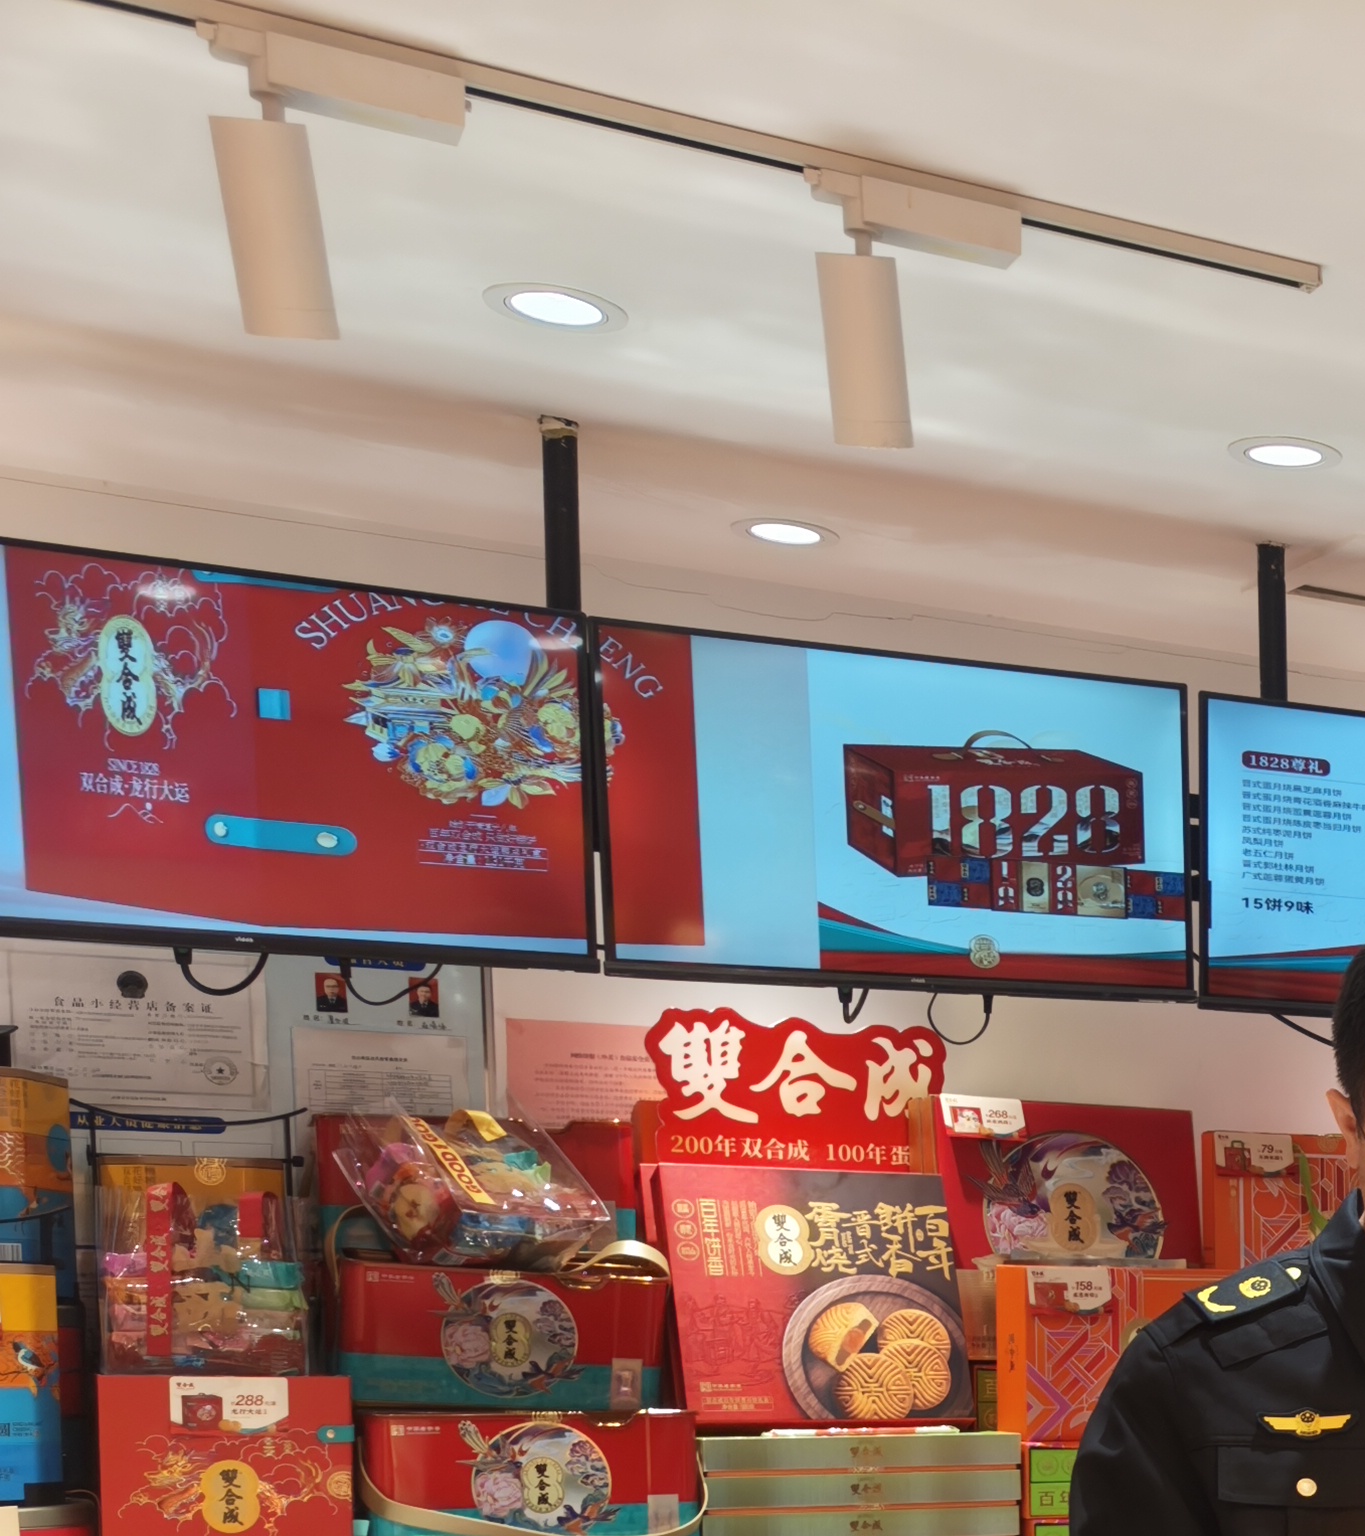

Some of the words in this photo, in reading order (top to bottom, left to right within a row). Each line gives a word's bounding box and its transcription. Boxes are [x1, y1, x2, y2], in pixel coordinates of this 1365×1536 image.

[115, 628, 142, 726] 雙合成
[1249, 754, 1324, 774] 1828尊礼
[927, 784, 1121, 860] 1828
[1241, 897, 1314, 915] 15饼9味
[658, 1021, 933, 1124] 雙合成
[988, 1109, 1009, 1120] 268
[670, 1134, 811, 1162] 200年双合成
[1261, 1144, 1274, 1154] 79
[1075, 1281, 1094, 1291] 158
[235, 1394, 265, 1407] 288
[218, 1468, 245, 1527] 雙合成
